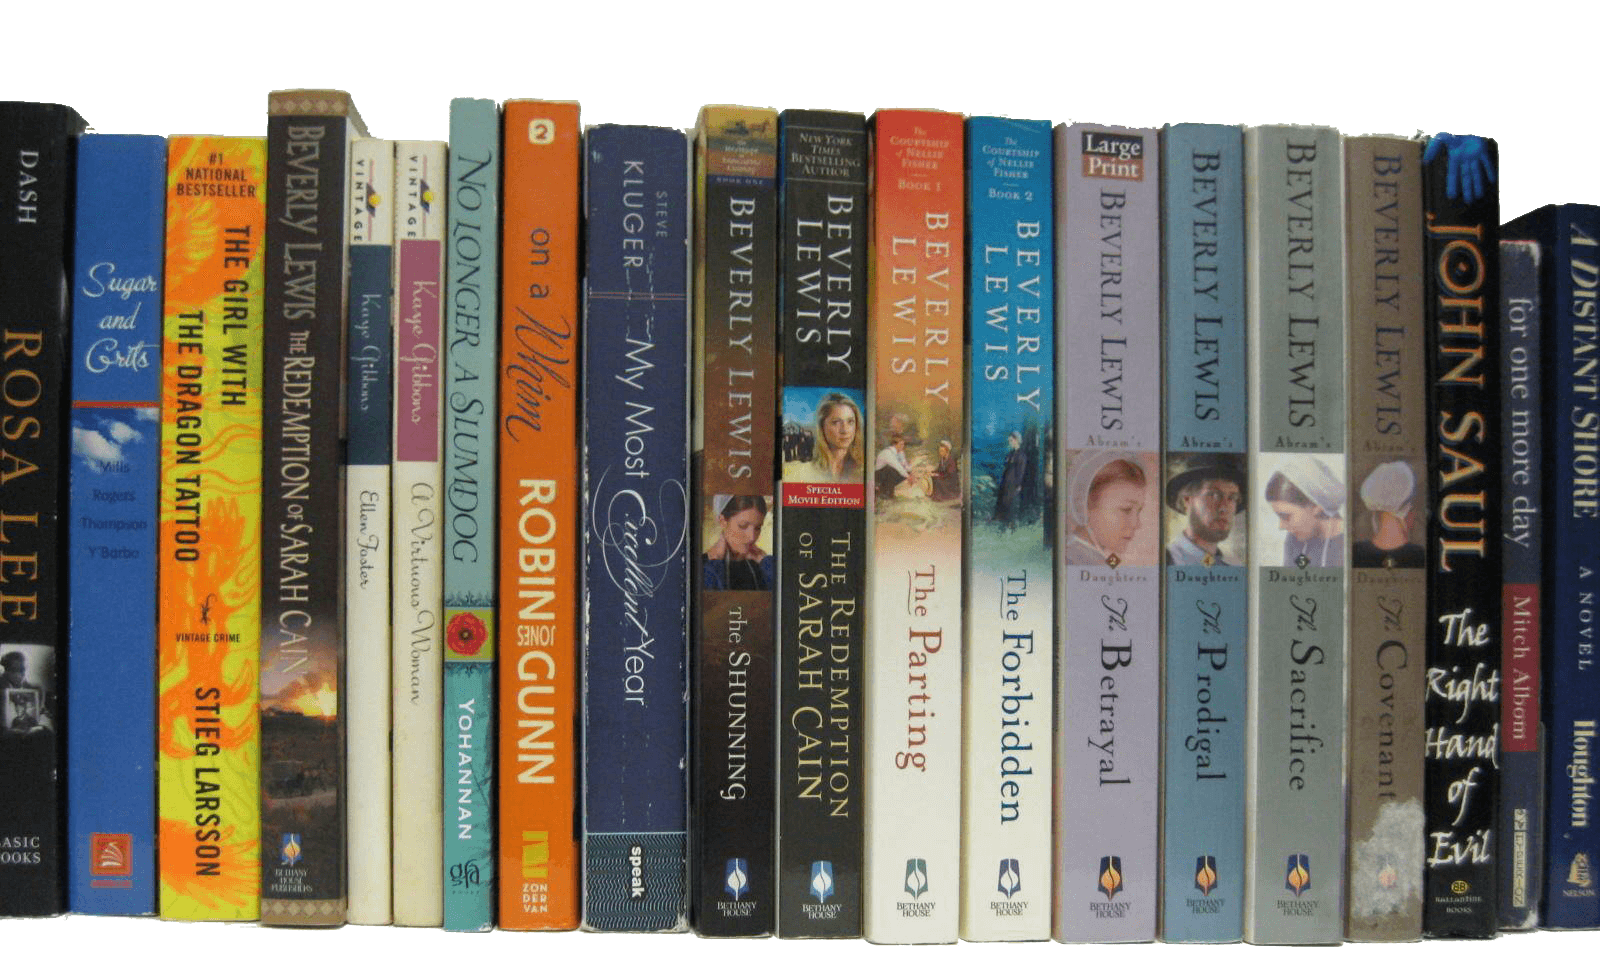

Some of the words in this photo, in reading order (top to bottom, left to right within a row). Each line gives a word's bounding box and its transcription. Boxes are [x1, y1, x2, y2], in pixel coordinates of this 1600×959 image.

[209, 153, 224, 165] #1
[535, 124, 548, 140] 2
[1085, 134, 1141, 159] Large
[18, 150, 40, 224] DASH
[177, 183, 256, 198] BESTSELLER
[186, 168, 248, 182] NATIONAL
[279, 126, 325, 235] BEVERLY
[898, 179, 931, 190] BOOK
[988, 188, 1020, 200] BOOK
[1024, 190, 1033, 201] 2
[1087, 158, 1140, 178] Print
[354, 158, 365, 242] VINTAGE
[407, 155, 419, 239] VINTAGE
[622, 160, 645, 269] KLUGER
[655, 190, 669, 239] STEVE
[1191, 149, 1220, 301] BEVERLY
[1286, 138, 1317, 301] BEVERLY
[224, 225, 250, 269] THE
[529, 227, 551, 266] on
[1100, 188, 1127, 325] BEVERLY
[1373, 152, 1403, 314] BEVERLY
[1569, 223, 1599, 248] A
[83, 262, 158, 300] Sugar
[283, 243, 323, 320] LEWIS
[449, 219, 482, 356] LONGER
[529, 283, 550, 299] a
[728, 196, 756, 355] BEVERLY
[795, 218, 823, 344] LEWIS
[826, 195, 855, 373] BEVERLY
[1426, 212, 1485, 391] JOHN
[98, 302, 142, 331] and
[178, 310, 204, 355] THE
[223, 279, 249, 336] GIRL
[354, 293, 382, 339] Kaye
[404, 280, 438, 339] Kaye
[891, 236, 917, 375] LEWIS
[924, 211, 950, 404] BEVERLY
[984, 245, 1009, 381] LEWIS
[1016, 219, 1041, 412] BEVERLY
[1508, 297, 1533, 337] for
[1569, 259, 1600, 400] DISTANT
[86, 337, 160, 373] Grits
[289, 330, 310, 355] THE
[615, 337, 655, 390] My
[1193, 312, 1223, 422] LEWIS
[1288, 312, 1320, 428] LEWIS
[222, 345, 248, 408] WITH
[350, 345, 381, 411] Gibbons
[400, 343, 437, 425] Gibbons
[455, 364, 479, 384] A
[505, 306, 571, 443] Whim
[1100, 334, 1128, 431] LEWIS
[1374, 324, 1405, 436] LEWIS
[1510, 347, 1529, 399] one
[0, 329, 42, 485] ROSA
[176, 366, 204, 465] DRAGON
[280, 356, 315, 500] REDEMPTION
[727, 368, 755, 480] LEWIS
[624, 401, 655, 478] Most
[1512, 410, 1530, 485] more
[1571, 406, 1599, 518] SHORE
[410, 482, 435, 506] A
[449, 391, 485, 564] SLUMDOG
[788, 495, 818, 504] MOVIE
[821, 496, 861, 505] EDITION
[806, 485, 842, 495] SPECIAL
[1438, 410, 1485, 572] SAUL
[81, 516, 148, 532] Thompson
[174, 475, 203, 563] TATTOO
[287, 503, 304, 521] OF
[359, 490, 380, 536] Ellen
[1503, 496, 1538, 548] day
[0, 511, 39, 624] LEE
[279, 523, 313, 602] SARAH
[357, 534, 380, 590] Foster
[410, 508, 435, 609] Virtuous
[517, 478, 557, 620] ROBIN
[798, 531, 814, 559] OF
[830, 531, 852, 584] THE
[1578, 566, 1594, 579] A
[913, 564, 936, 617] The
[1006, 569, 1028, 621] The
[1080, 569, 1147, 587] Daughters
[1175, 569, 1239, 586] Daughters
[1268, 569, 1337, 586] Daughters
[176, 633, 210, 643] VINTAGE
[213, 633, 241, 643] CRIME
[279, 609, 312, 674] CAIN
[516, 624, 557, 648] JONES
[796, 571, 828, 690] SARAH
[1100, 594, 1128, 633] The
[1195, 599, 1222, 635] The
[1289, 594, 1317, 633] The
[1439, 608, 1490, 646] The
[1511, 596, 1532, 659] Mitch
[1578, 591, 1594, 671] NOVEL
[410, 609, 436, 706] Woman
[623, 637, 655, 706] Year
[516, 650, 556, 785] GUNN
[829, 597, 856, 818] REDEMPTION
[895, 627, 943, 772] Parting
[1088, 639, 1133, 787] Betrayal
[1185, 642, 1229, 782] Prodigal
[1289, 638, 1326, 791] Sacrifice
[1375, 639, 1408, 800] Covenant
[1425, 663, 1500, 724] Right
[1511, 668, 1538, 741] Albom
[194, 687, 221, 757] STIEG
[720, 651, 751, 802] SHUNNING
[1000, 630, 1034, 825] Forbidden
[1425, 723, 1499, 769] Hand
[457, 698, 476, 840] YOHANNAN
[791, 706, 823, 802] CAIN
[1566, 720, 1596, 827] Houghton
[194, 767, 221, 877] LARSSON
[1447, 767, 1480, 826] of
[0, 836, 40, 848] ASIC
[0, 851, 41, 864] OOKS
[1427, 830, 1491, 867] Evil
[522, 894, 548, 903] DER
[523, 884, 548, 893] ZON
[629, 846, 642, 899] speak
[1562, 889, 1596, 897] NELSON
[523, 904, 548, 913] VAN
[717, 901, 757, 910] BETHANY
[723, 909, 752, 917] HOUSE
[802, 903, 842, 912] BETHANY
[807, 911, 837, 919] HOUSE
[896, 902, 936, 910] BETHANY
[902, 909, 931, 917] HOUSE
[990, 901, 1029, 910] BETHANY
[996, 908, 1024, 917] HOUSE
[1089, 902, 1132, 911] BETHANY
[1095, 909, 1126, 918] HOUSE
[1186, 899, 1226, 908] BETHANY
[1191, 905, 1221, 914] HOUSE
[1277, 900, 1320, 909] BETHANY
[1283, 907, 1315, 916] HOUSE
